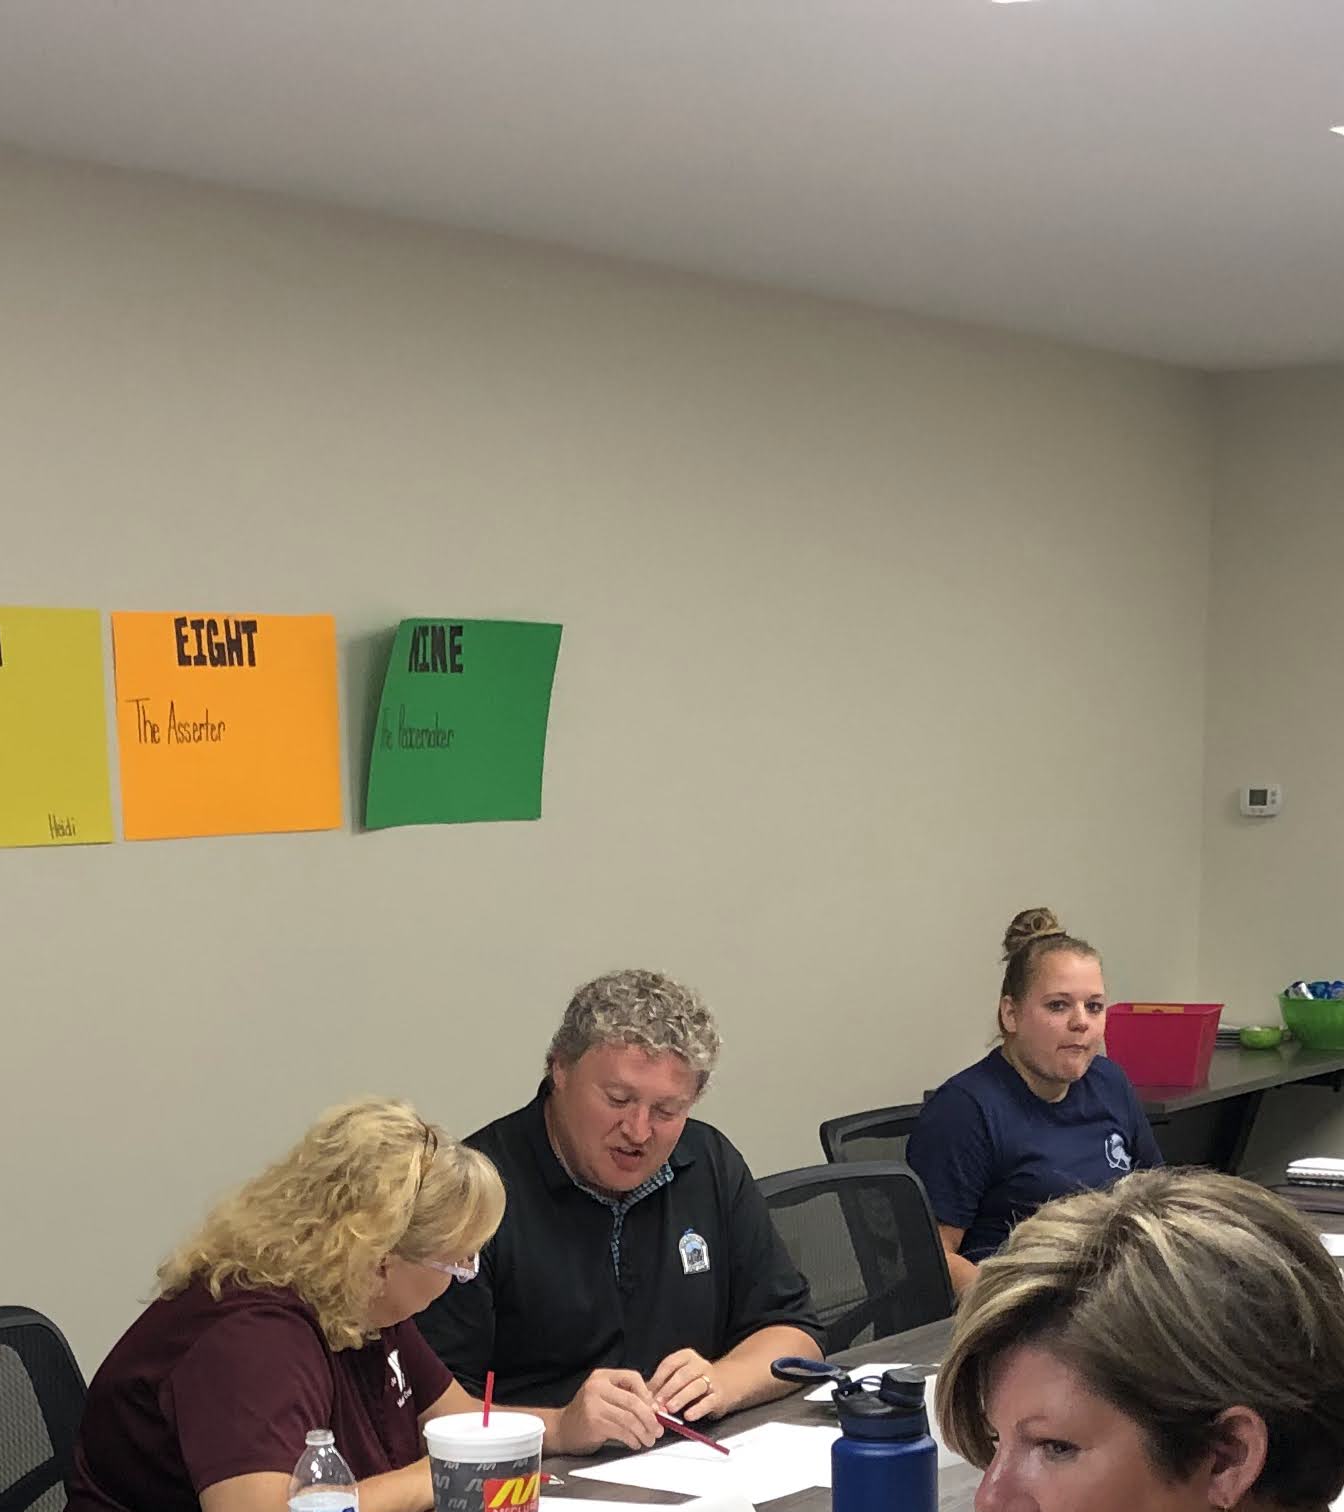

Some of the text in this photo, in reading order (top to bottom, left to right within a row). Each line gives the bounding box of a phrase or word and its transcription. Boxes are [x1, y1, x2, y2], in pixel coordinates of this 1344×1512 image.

[174, 616, 257, 668] EIGHT
[408, 625, 464, 674] NINE
[125, 697, 226, 745] The Asserter
[48, 814, 77, 839] Heidi
